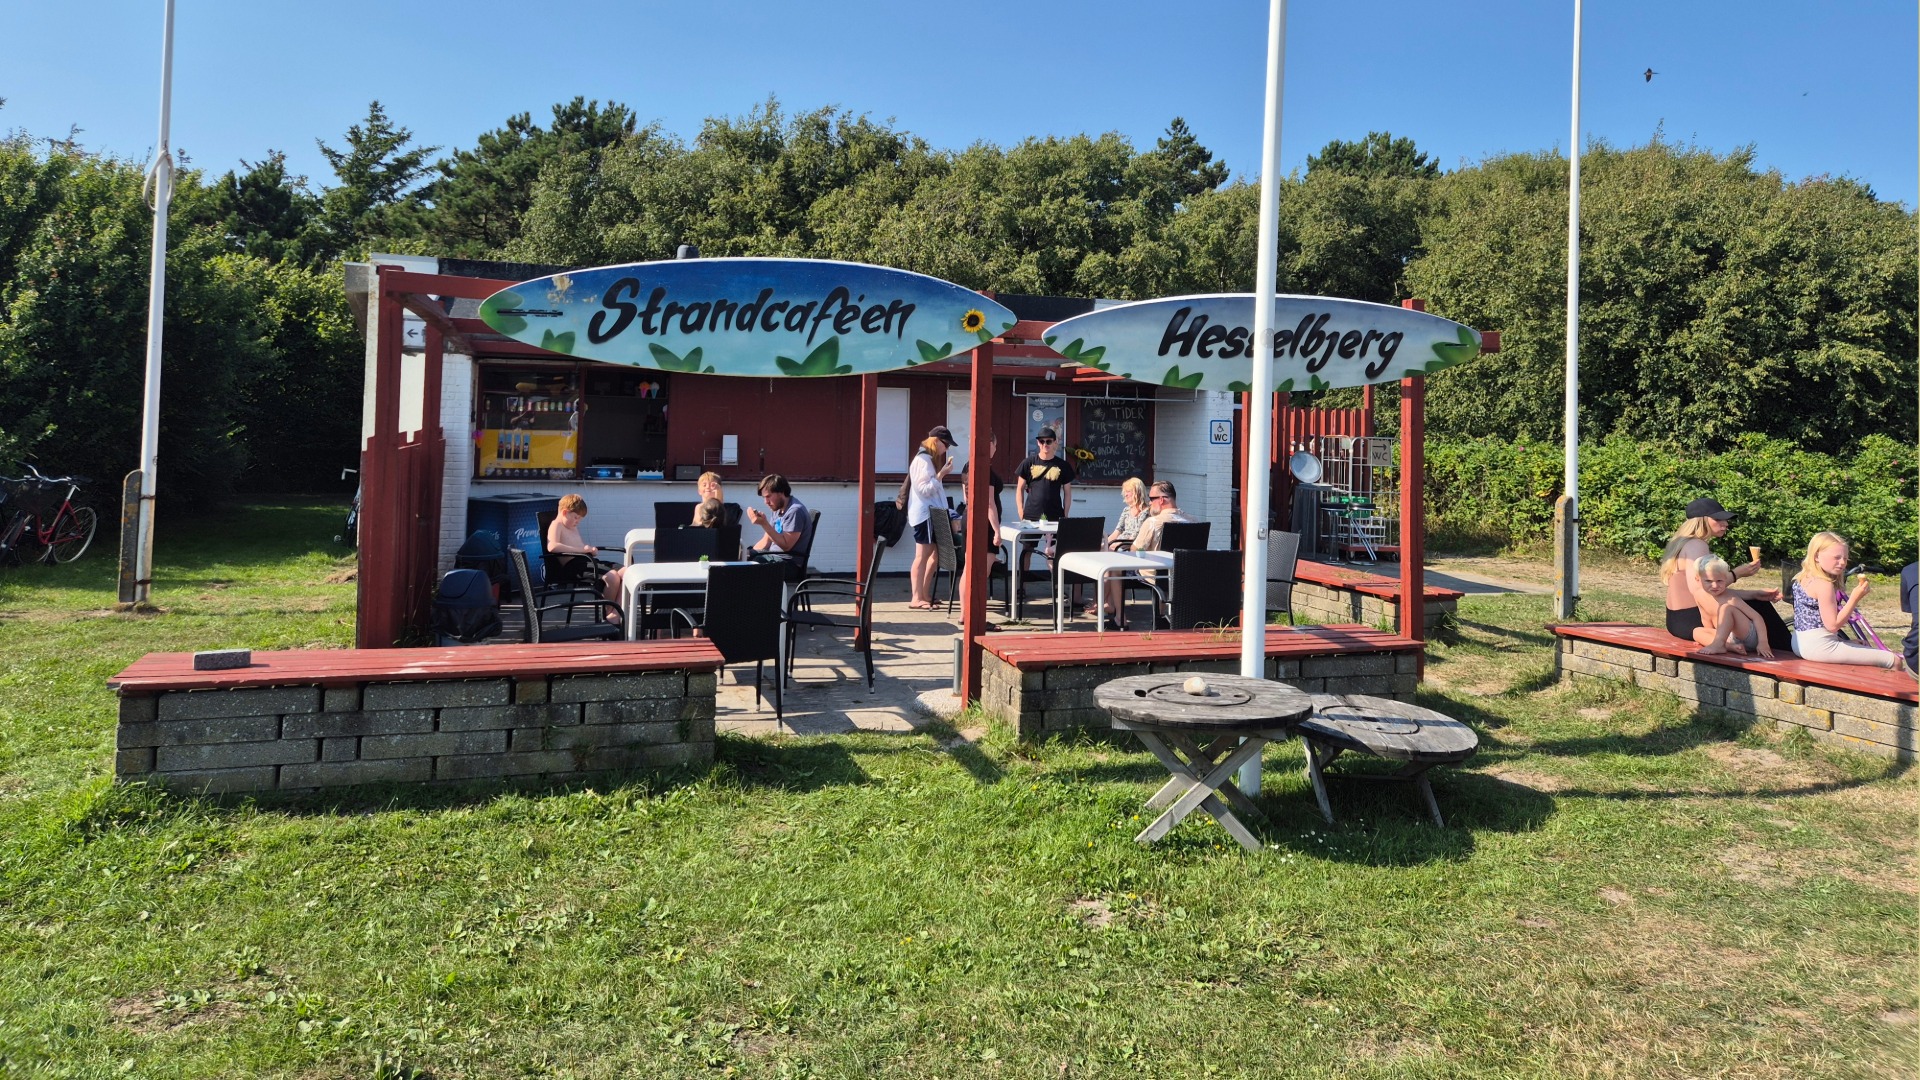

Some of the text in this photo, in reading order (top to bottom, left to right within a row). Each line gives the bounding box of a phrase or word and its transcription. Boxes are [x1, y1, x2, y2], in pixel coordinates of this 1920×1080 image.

[588, 277, 916, 347] Strandcaféen
[1157, 306, 1404, 379] Heselbjerg
[1214, 433, 1228, 442] WC
[1372, 452, 1388, 461] WC
